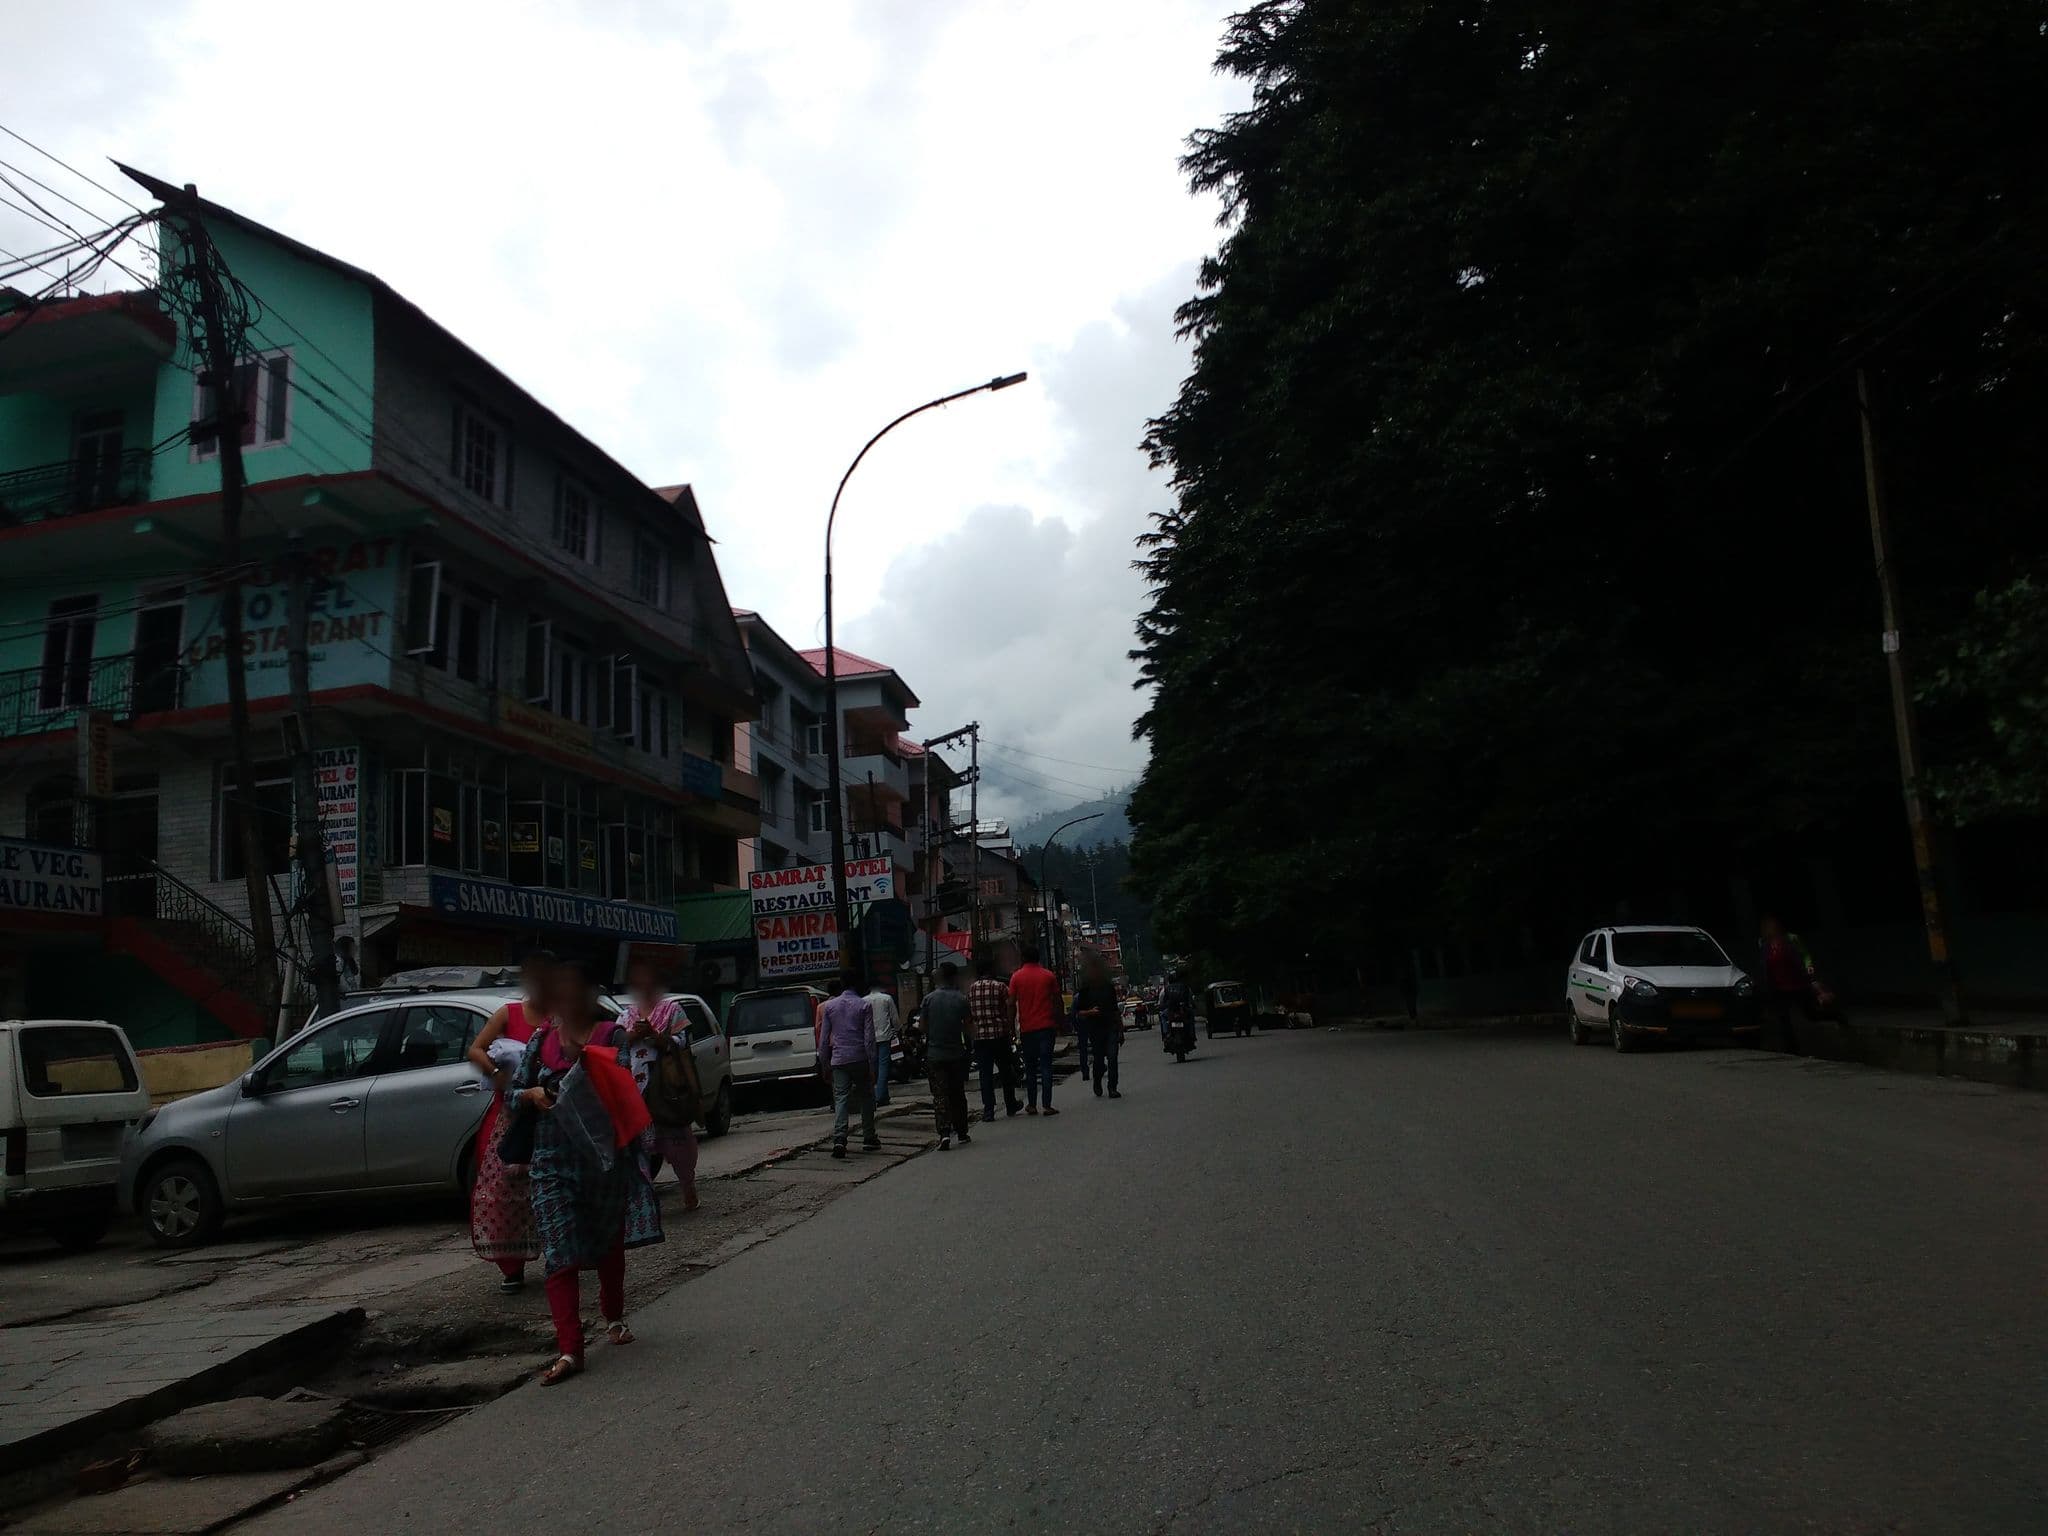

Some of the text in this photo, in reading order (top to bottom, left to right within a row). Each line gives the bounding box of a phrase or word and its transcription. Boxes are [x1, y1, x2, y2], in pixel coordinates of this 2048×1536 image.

[320, 750, 357, 767] MRAT
[320, 769, 340, 783] TEL
[319, 784, 357, 802] AURANT
[31, 850, 88, 879] VEG.
[751, 858, 891, 890] SAMRAT OTEL
[458, 882, 677, 938] SAMRAT HOTEL & RESTAURANT
[753, 886, 872, 914] RESTAURNT
[756, 911, 839, 940] SAMRA
[777, 937, 831, 953] HOTEL
